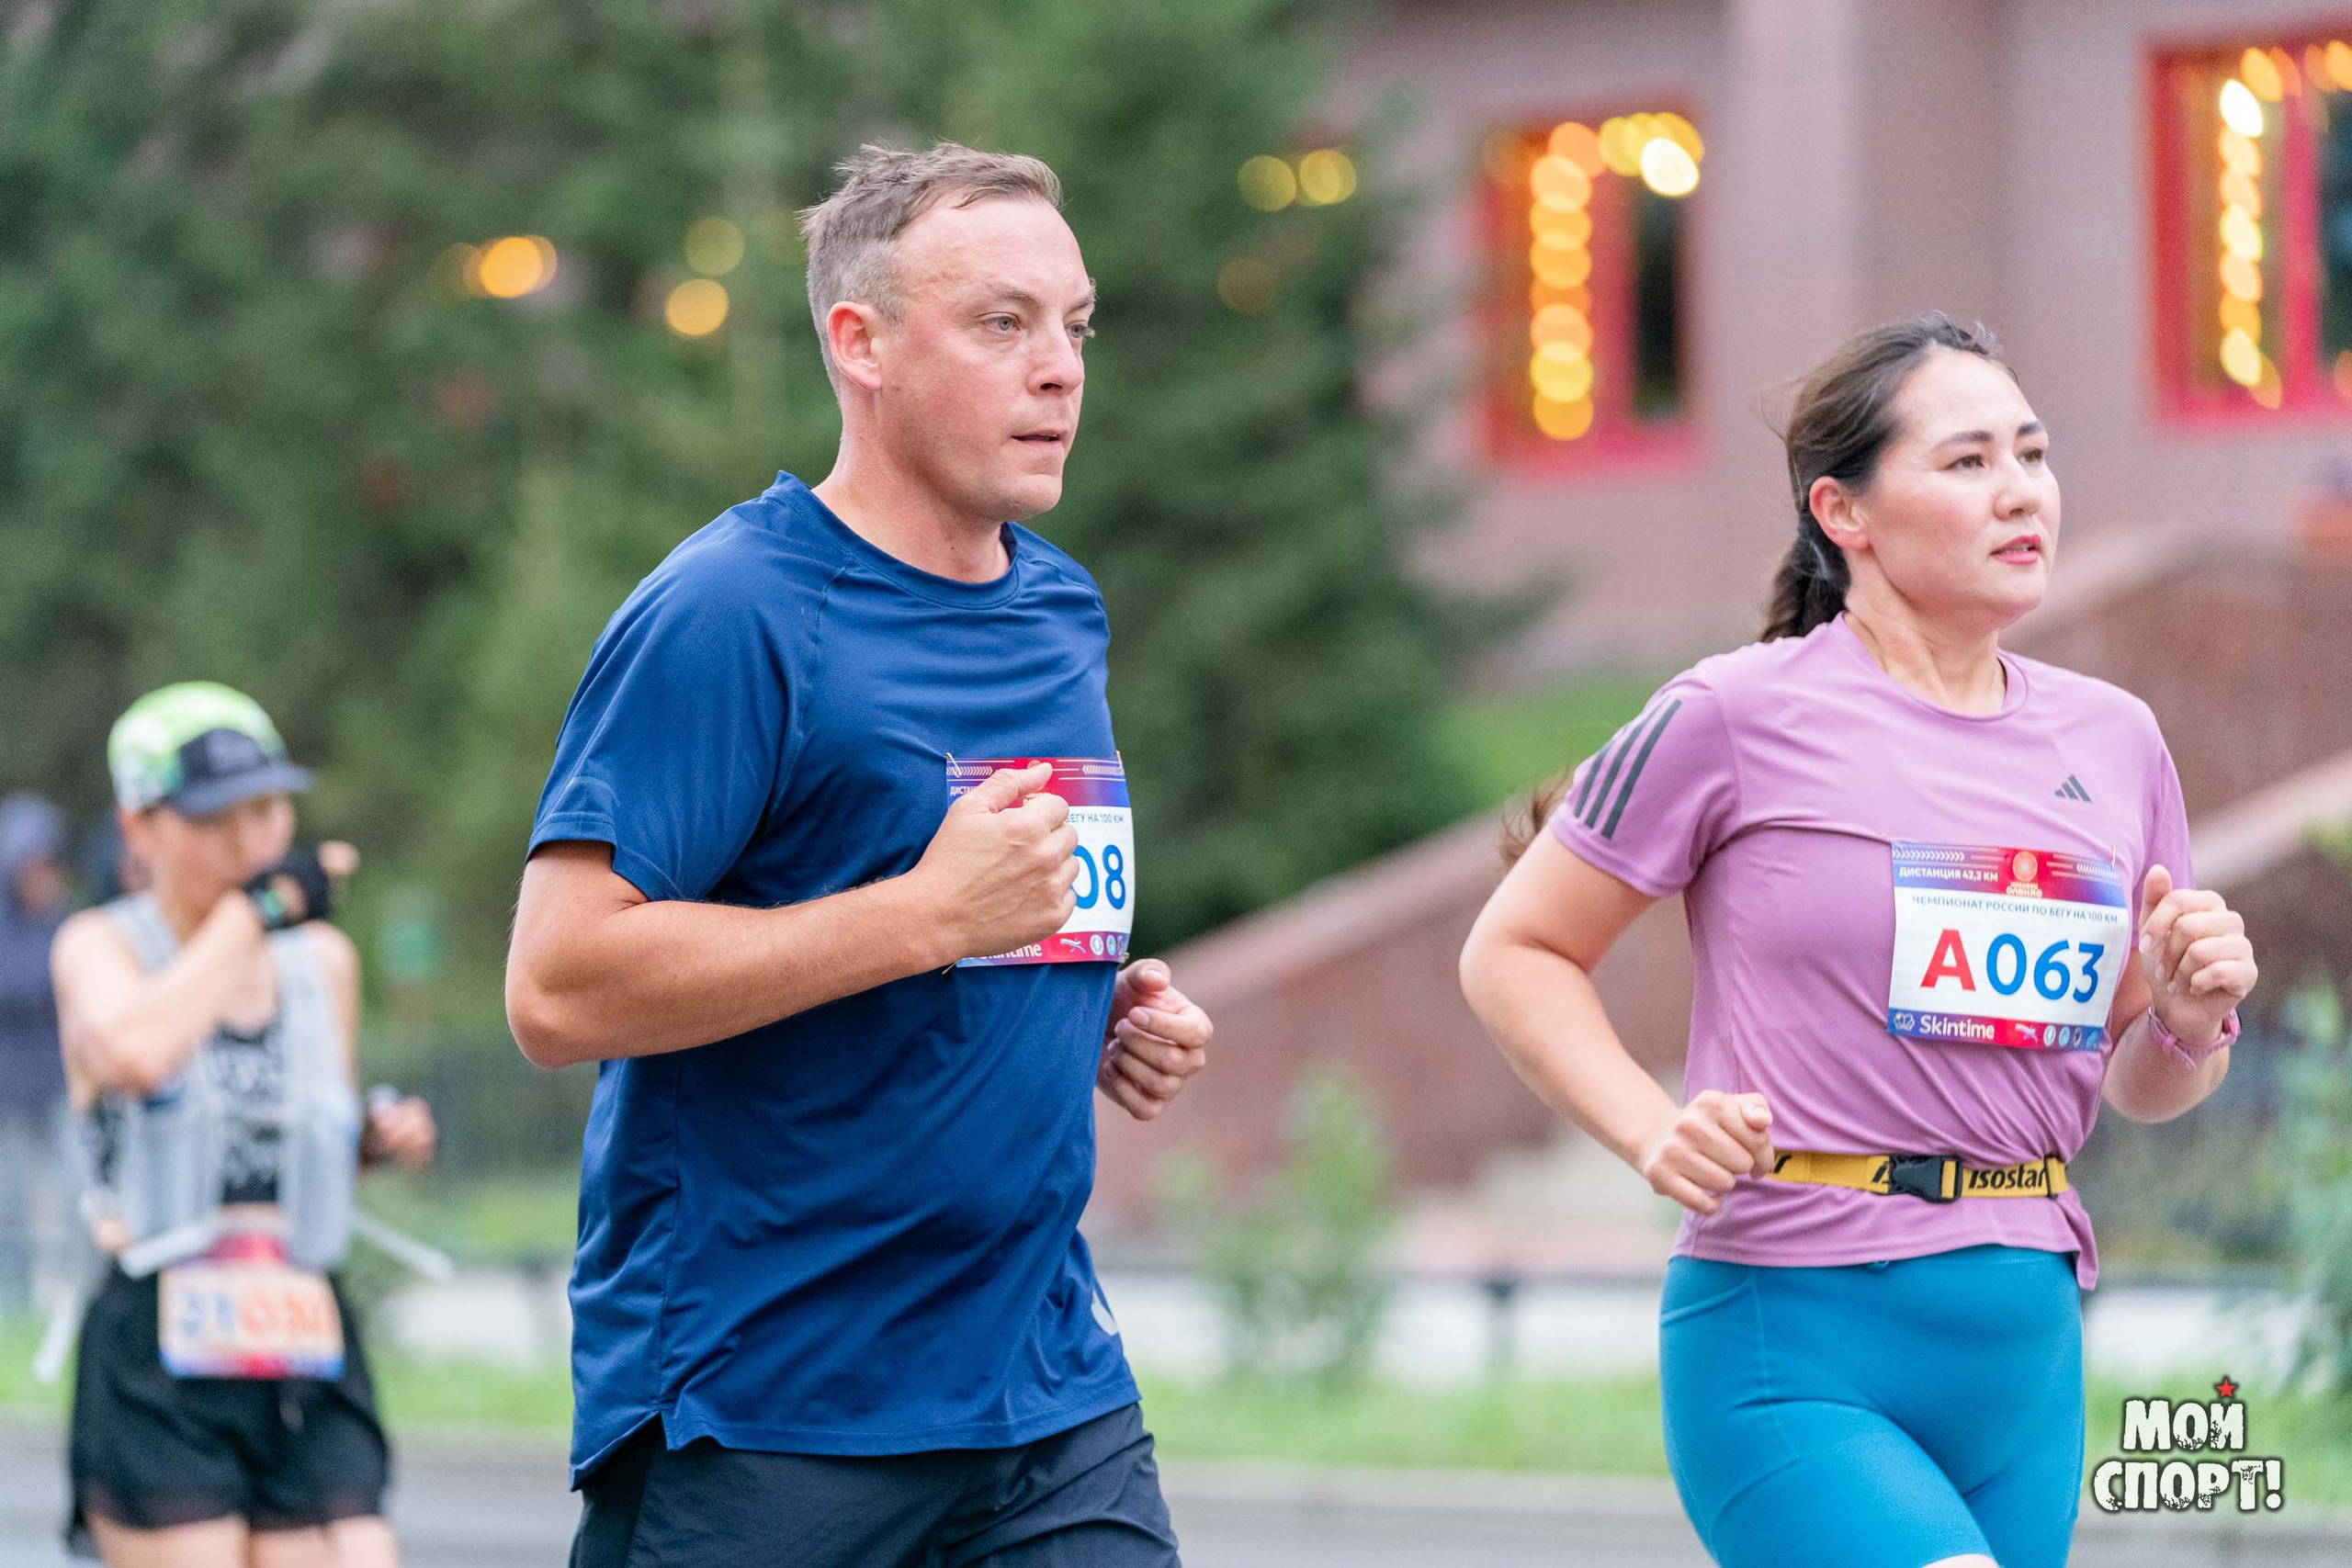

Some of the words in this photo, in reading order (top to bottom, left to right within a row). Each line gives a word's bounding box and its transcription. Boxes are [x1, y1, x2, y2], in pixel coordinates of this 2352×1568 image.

[1088, 814, 1099, 823] НА
[1899, 867, 1961, 880] ДИСТАНЦИЯ
[1962, 870, 1982, 882] 42,2
[1983, 872, 1998, 883] КМ
[1912, 895, 1983, 909] ЧЕМПИОНАТ
[1986, 900, 2030, 913] РОССИИ
[2032, 906, 2047, 916] ПО
[2050, 907, 2071, 919] БЕГУ
[2074, 910, 2086, 919] НА
[2088, 911, 2103, 922] 100
[2105, 913, 2118, 924] КМ
[1919, 1013, 1996, 1041] Skintime
